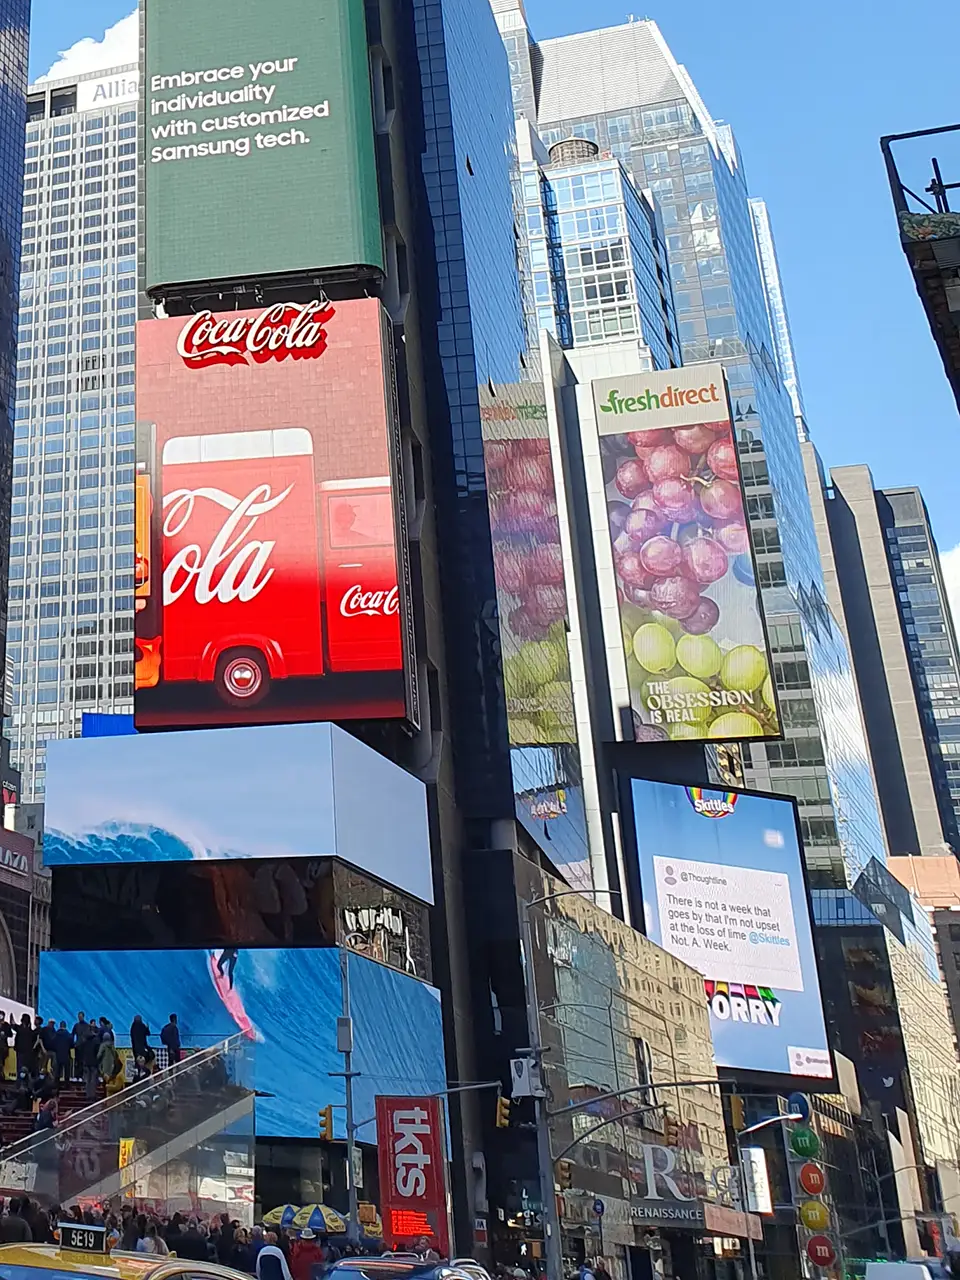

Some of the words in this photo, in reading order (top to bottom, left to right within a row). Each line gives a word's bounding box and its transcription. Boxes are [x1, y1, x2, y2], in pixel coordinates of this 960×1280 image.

[150, 63, 244, 92] Embrace
[248, 57, 298, 81] your
[150, 83, 276, 116] individuality
[151, 118, 197, 140] with
[201, 100, 330, 132] customized
[150, 136, 250, 164] Samsung
[255, 128, 311, 149] tech.
[177, 300, 334, 365] Coca-Cola
[605, 382, 721, 416] freshdirect
[646, 681, 670, 696] THE
[646, 688, 755, 710] OBSESSION
[649, 710, 663, 724] IS
[666, 708, 701, 723] REAL.
[694, 798, 735, 814] Skittles
[681, 871, 727, 886] @Thoughtline
[666, 893, 693, 908] There
[695, 896, 703, 909] is
[705, 899, 720, 911] not
[721, 903, 728, 913] a
[728, 902, 753, 915] week
[754, 905, 772, 918] that
[667, 910, 690, 922] goes
[692, 910, 704, 926] by
[705, 912, 722, 925] that
[724, 914, 738, 926] I'm
[739, 917, 754, 930] not
[755, 919, 781, 933] upset
[669, 922, 680, 933] at
[681, 922, 695, 935] the
[696, 924, 716, 937] loss
[717, 926, 727, 939] of
[727, 928, 748, 941] lime
[749, 932, 791, 948] @Skittles
[671, 934, 689, 947] Not.
[691, 937, 702, 949] A.
[703, 938, 732, 953] Week.
[393, 1106, 431, 1198] tkts
[641, 1143, 696, 1203] R
[630, 1206, 703, 1221] RENAISSANCE
[70, 1231, 96, 1248] 5E19
